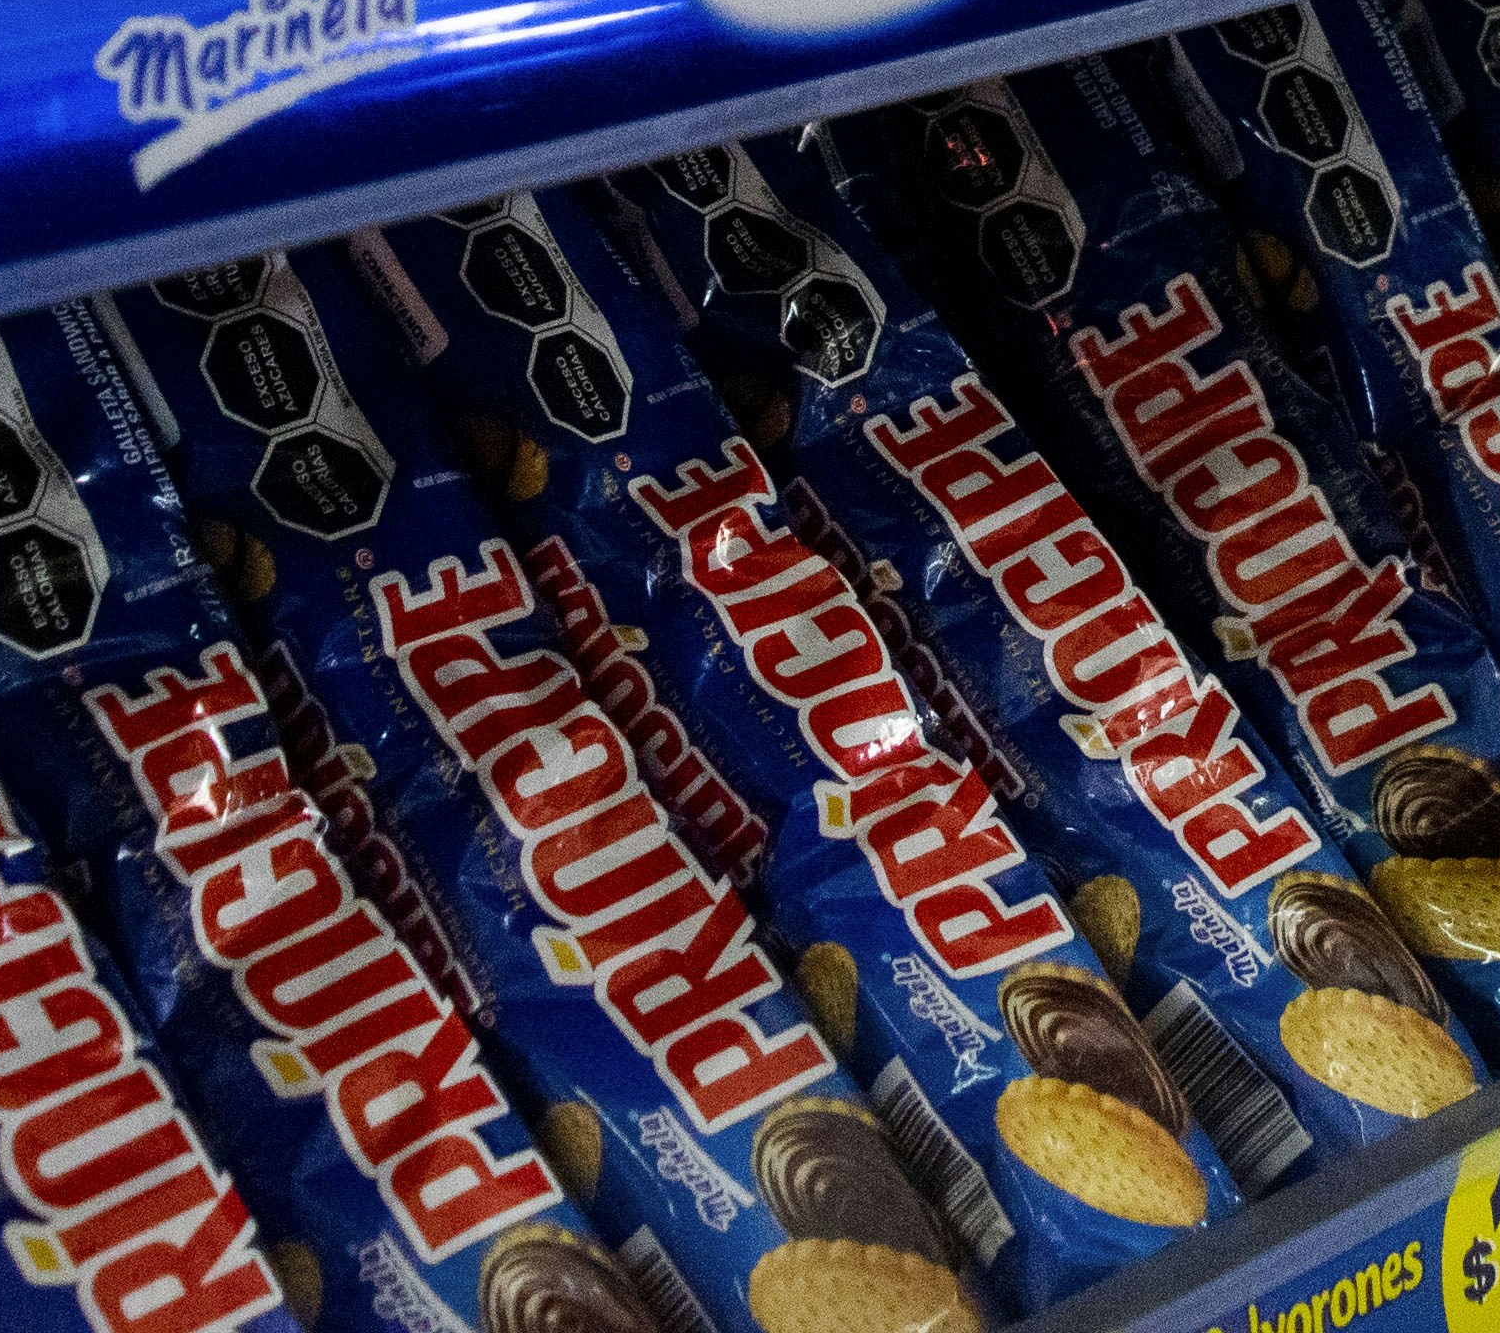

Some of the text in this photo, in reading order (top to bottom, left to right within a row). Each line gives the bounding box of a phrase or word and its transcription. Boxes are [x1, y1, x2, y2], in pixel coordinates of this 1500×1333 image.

[492, 245, 538, 312] EXCESO
[500, 231, 557, 314] AZUCARES
[51, 303, 143, 466] GALLETA SANDWIC
[235, 340, 277, 412] EXCESO
[249, 321, 299, 415] AZUCARES
[554, 354, 597, 423] EXCESO
[563, 343, 612, 426] CALORIAS
[8, 552, 50, 632] EXCESO
[22, 536, 71, 636] CALORIAS
[1169, 873, 1271, 988] Marinela
[892, 953, 1005, 1066] Marinela
[635, 1105, 755, 1231] Marinela
[1245, 1239, 1424, 1333] lvorones
